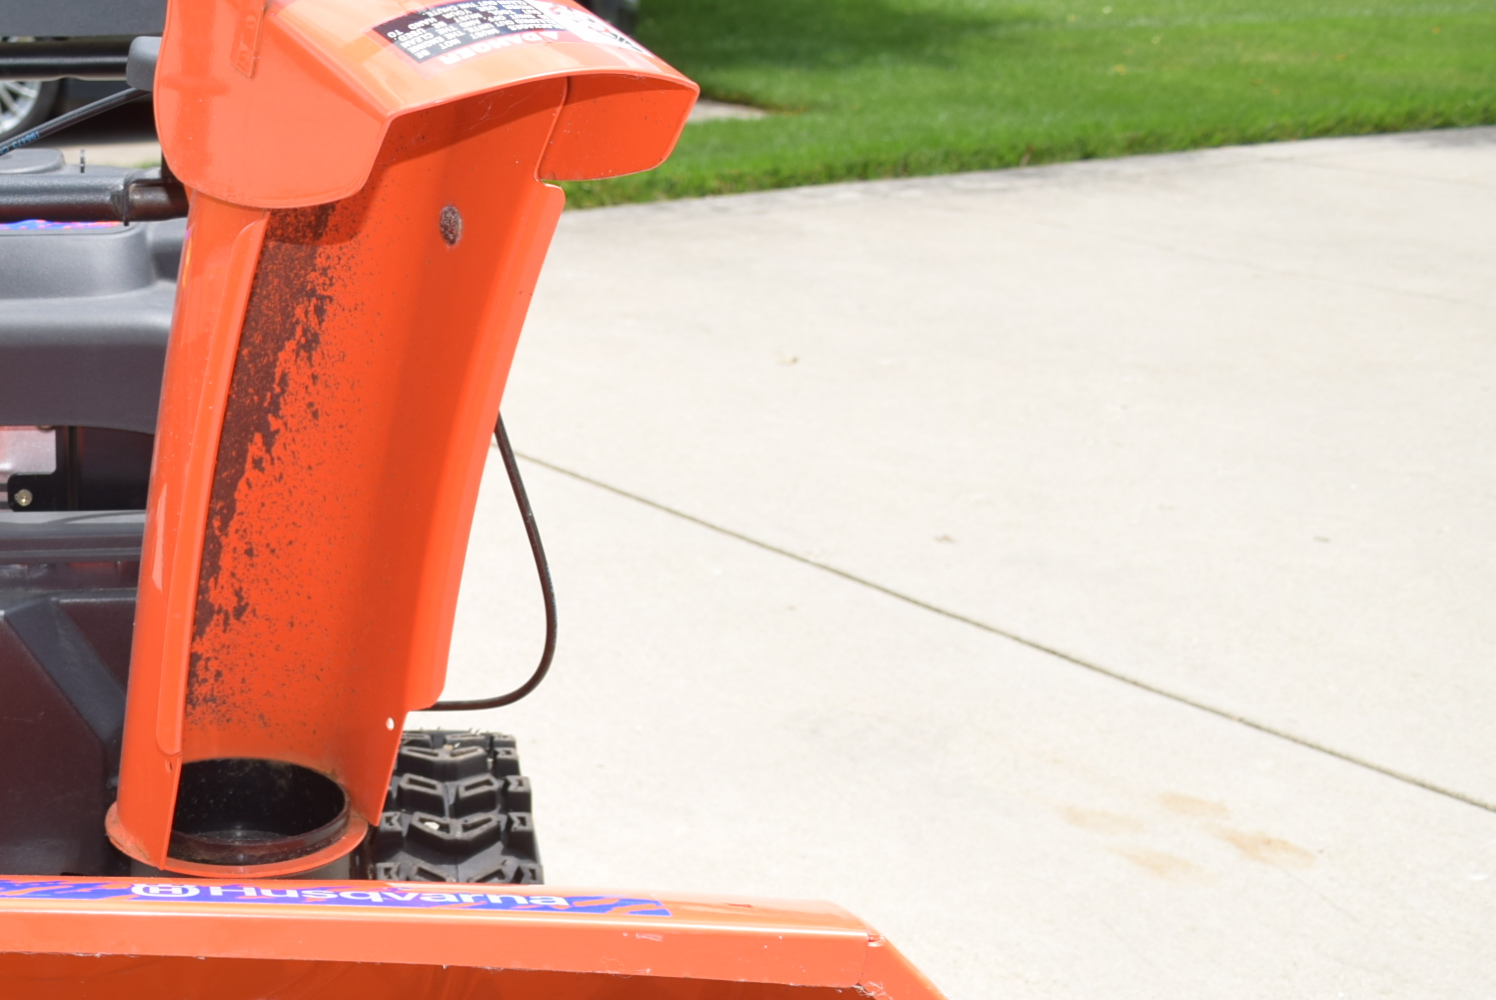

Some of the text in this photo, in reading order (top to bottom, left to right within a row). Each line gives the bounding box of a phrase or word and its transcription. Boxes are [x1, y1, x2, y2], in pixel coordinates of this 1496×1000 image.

[407, 17, 438, 30] HAND
[387, 29, 404, 38] TO
[435, 25, 459, 35] THE
[442, 30, 465, 40] THE
[470, 28, 500, 40] MUST
[400, 32, 434, 48] CLEAN
[407, 36, 445, 53] ENGINE
[438, 39, 461, 50] NOT
[414, 49, 431, 59] BE
[438, 32, 543, 64] DANGER
[209, 885, 571, 907] Husqvarna
